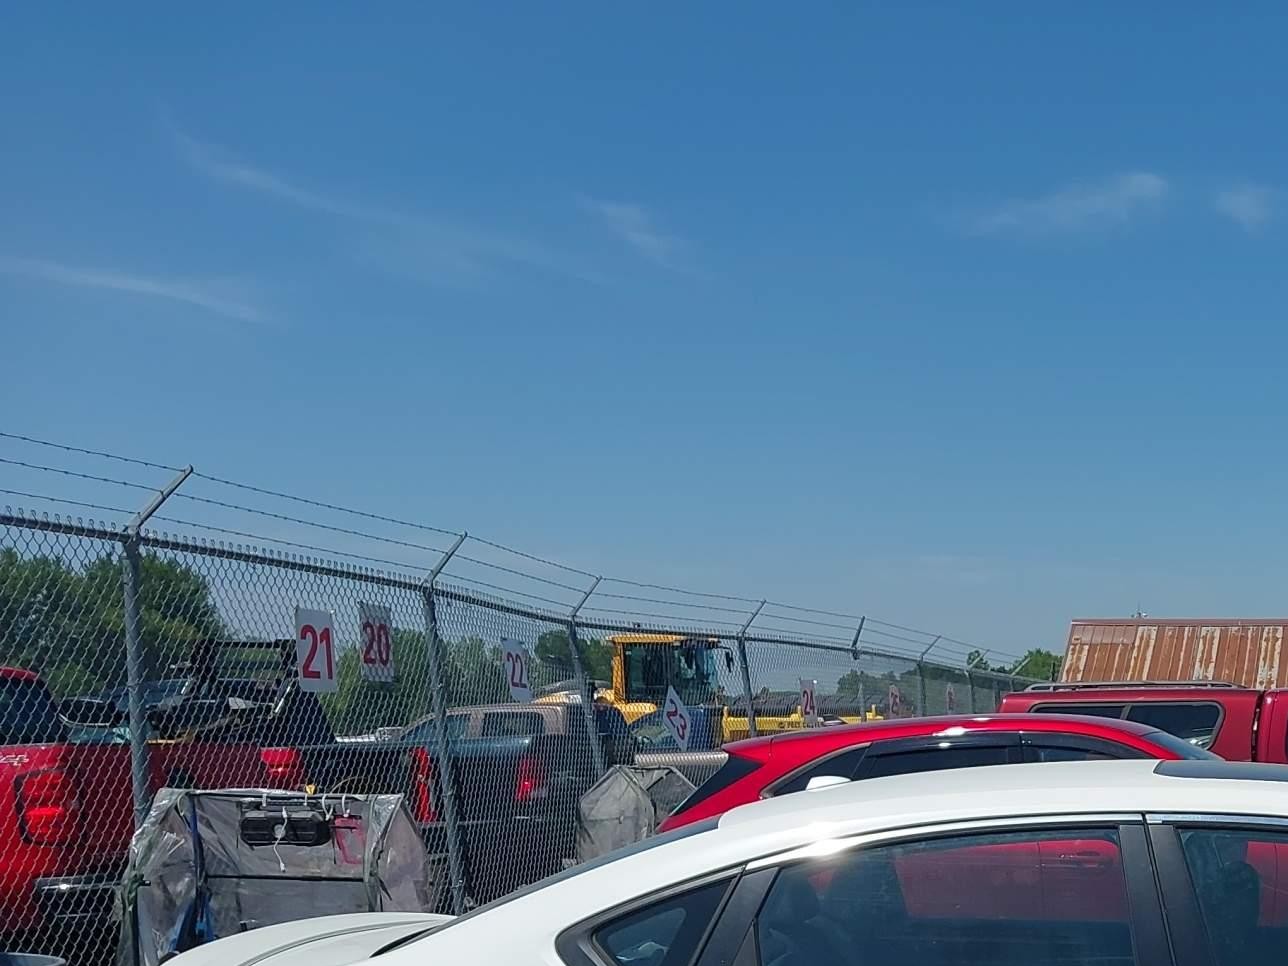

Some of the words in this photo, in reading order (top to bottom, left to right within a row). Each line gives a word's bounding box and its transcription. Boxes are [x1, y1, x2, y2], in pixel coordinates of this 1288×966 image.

[300, 624, 333, 681] 21
[362, 621, 390, 667] 20
[507, 652, 528, 689] 22
[666, 698, 688, 740] 23
[802, 690, 815, 716] 24
